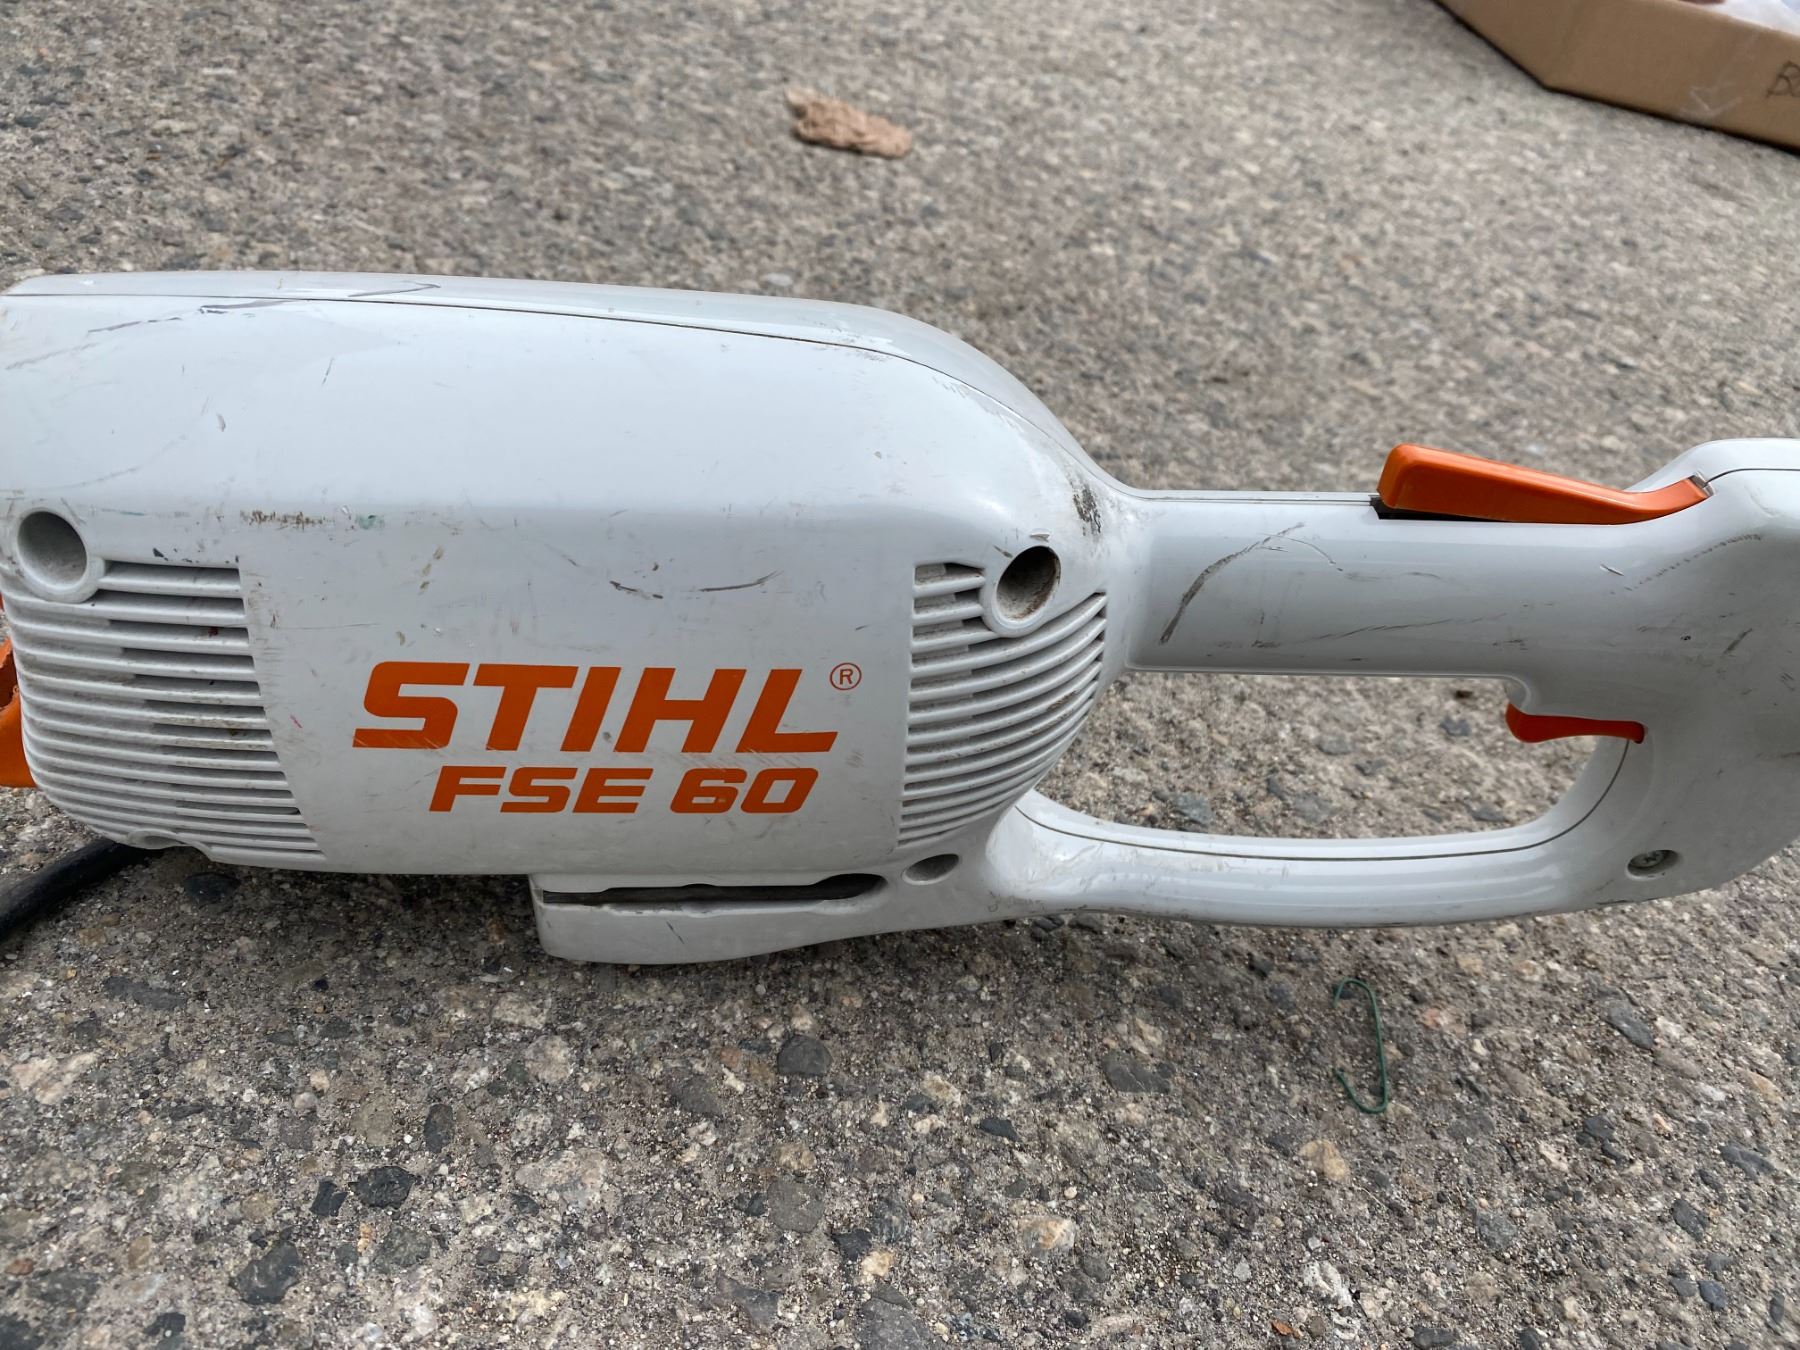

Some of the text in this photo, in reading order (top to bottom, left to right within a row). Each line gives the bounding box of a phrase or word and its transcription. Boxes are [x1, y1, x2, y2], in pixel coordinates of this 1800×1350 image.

[353, 661, 837, 754] STIHL
[430, 765, 819, 814] FSE 60
